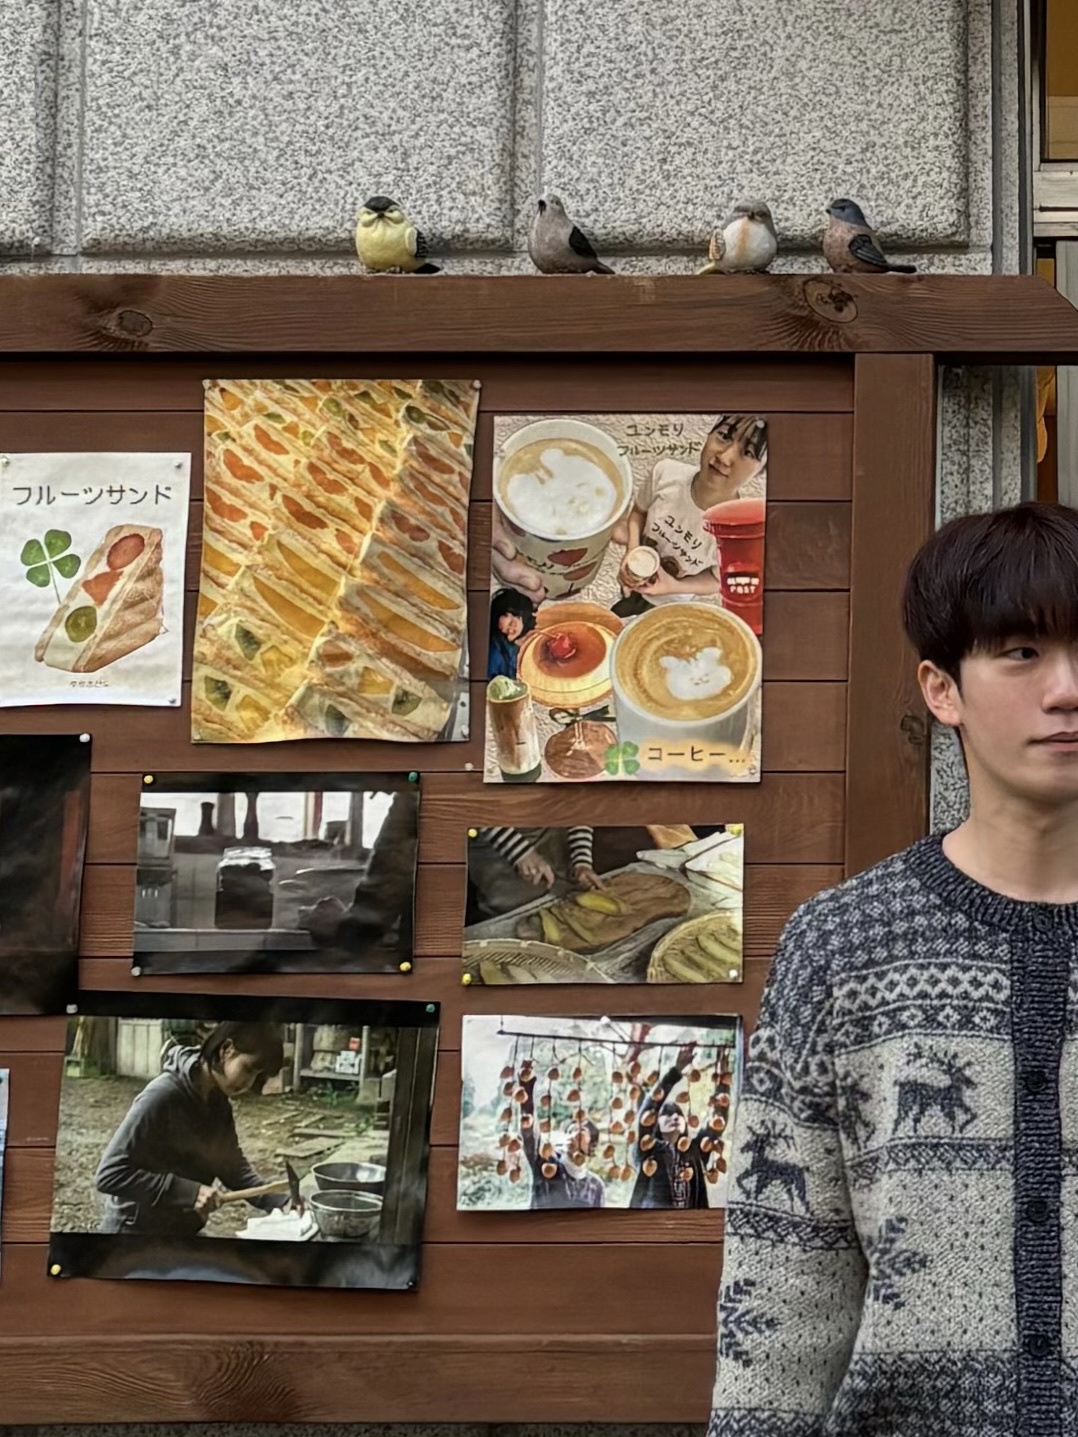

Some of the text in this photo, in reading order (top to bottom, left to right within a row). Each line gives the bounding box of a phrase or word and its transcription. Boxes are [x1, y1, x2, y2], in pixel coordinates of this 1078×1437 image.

[617, 441, 702, 456] フルーツサンド
[13, 484, 172, 505] フルーツサンド
